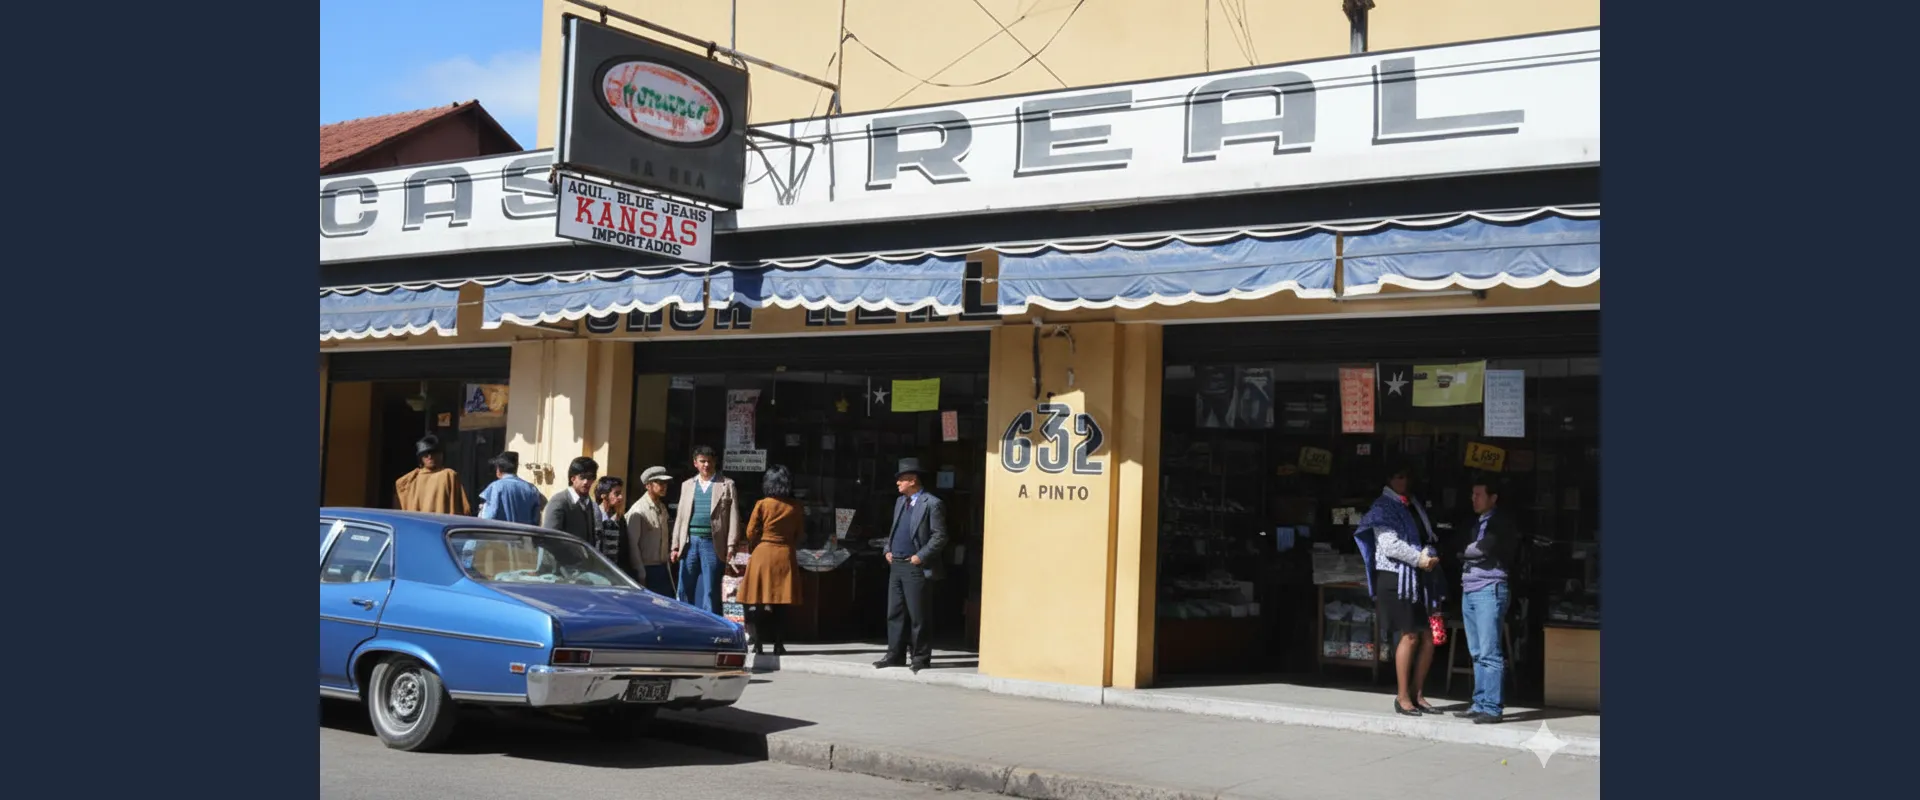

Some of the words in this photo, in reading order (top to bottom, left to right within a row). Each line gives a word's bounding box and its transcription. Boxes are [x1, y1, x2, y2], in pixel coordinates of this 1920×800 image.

[865, 57, 1525, 190] REAL
[617, 191, 654, 210] BLUE
[575, 196, 698, 246] KANSAS
[591, 227, 682, 256] IMPORTADOS
[1001, 403, 1104, 475] 632
[1038, 485, 1089, 500] PINTO
